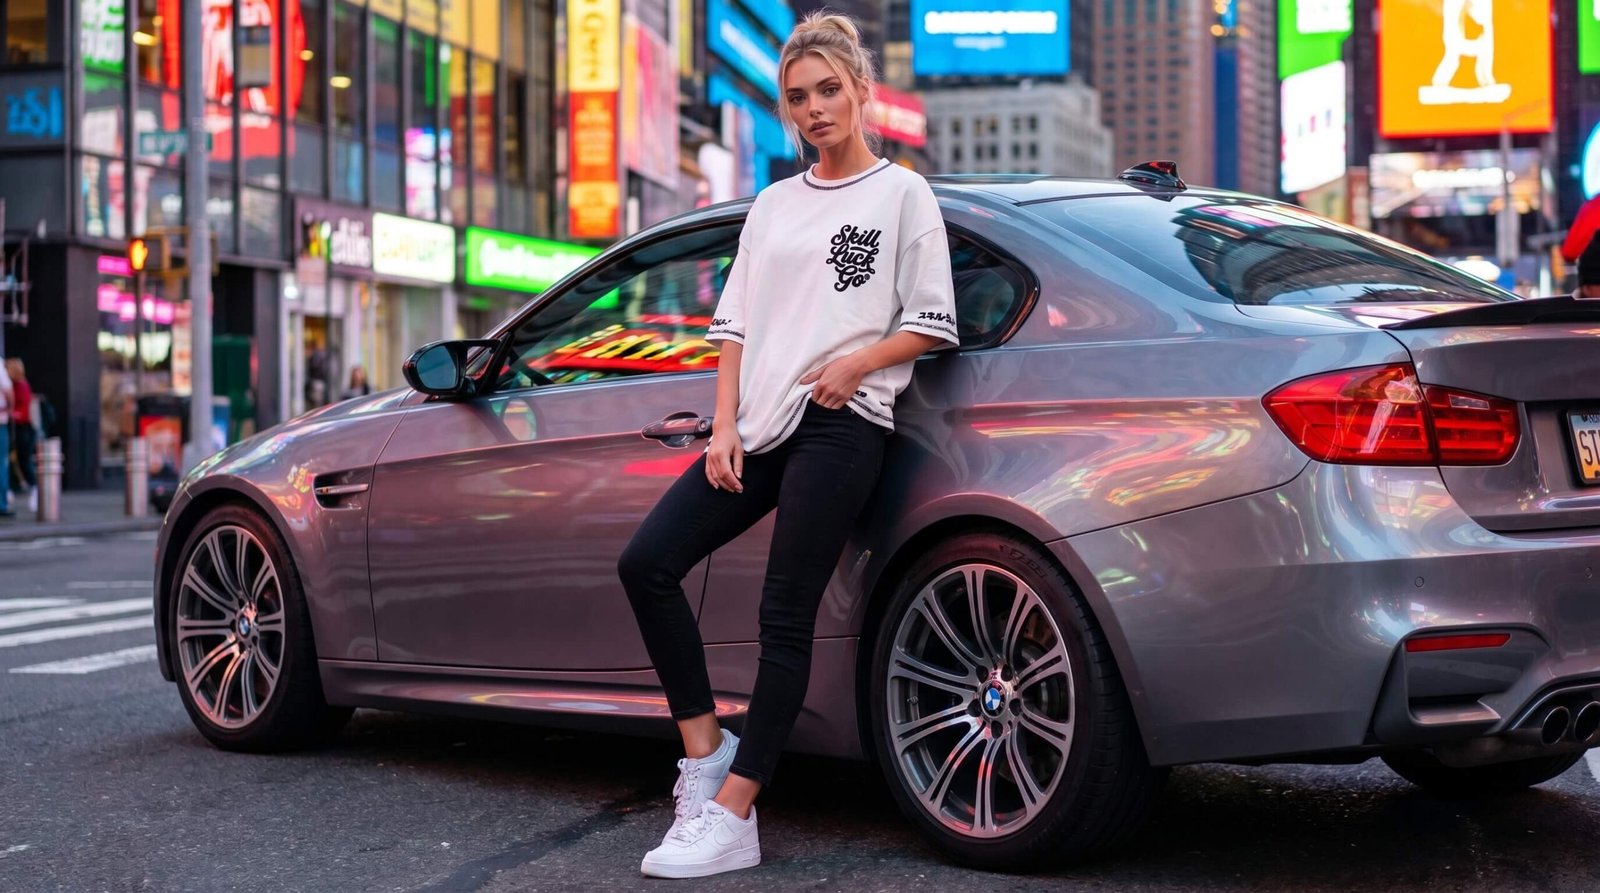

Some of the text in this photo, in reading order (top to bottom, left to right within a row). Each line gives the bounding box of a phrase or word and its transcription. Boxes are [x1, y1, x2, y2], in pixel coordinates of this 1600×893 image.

[830, 224, 882, 248] Skill
[825, 243, 880, 274] Luck
[1579, 429, 1600, 466] ST
